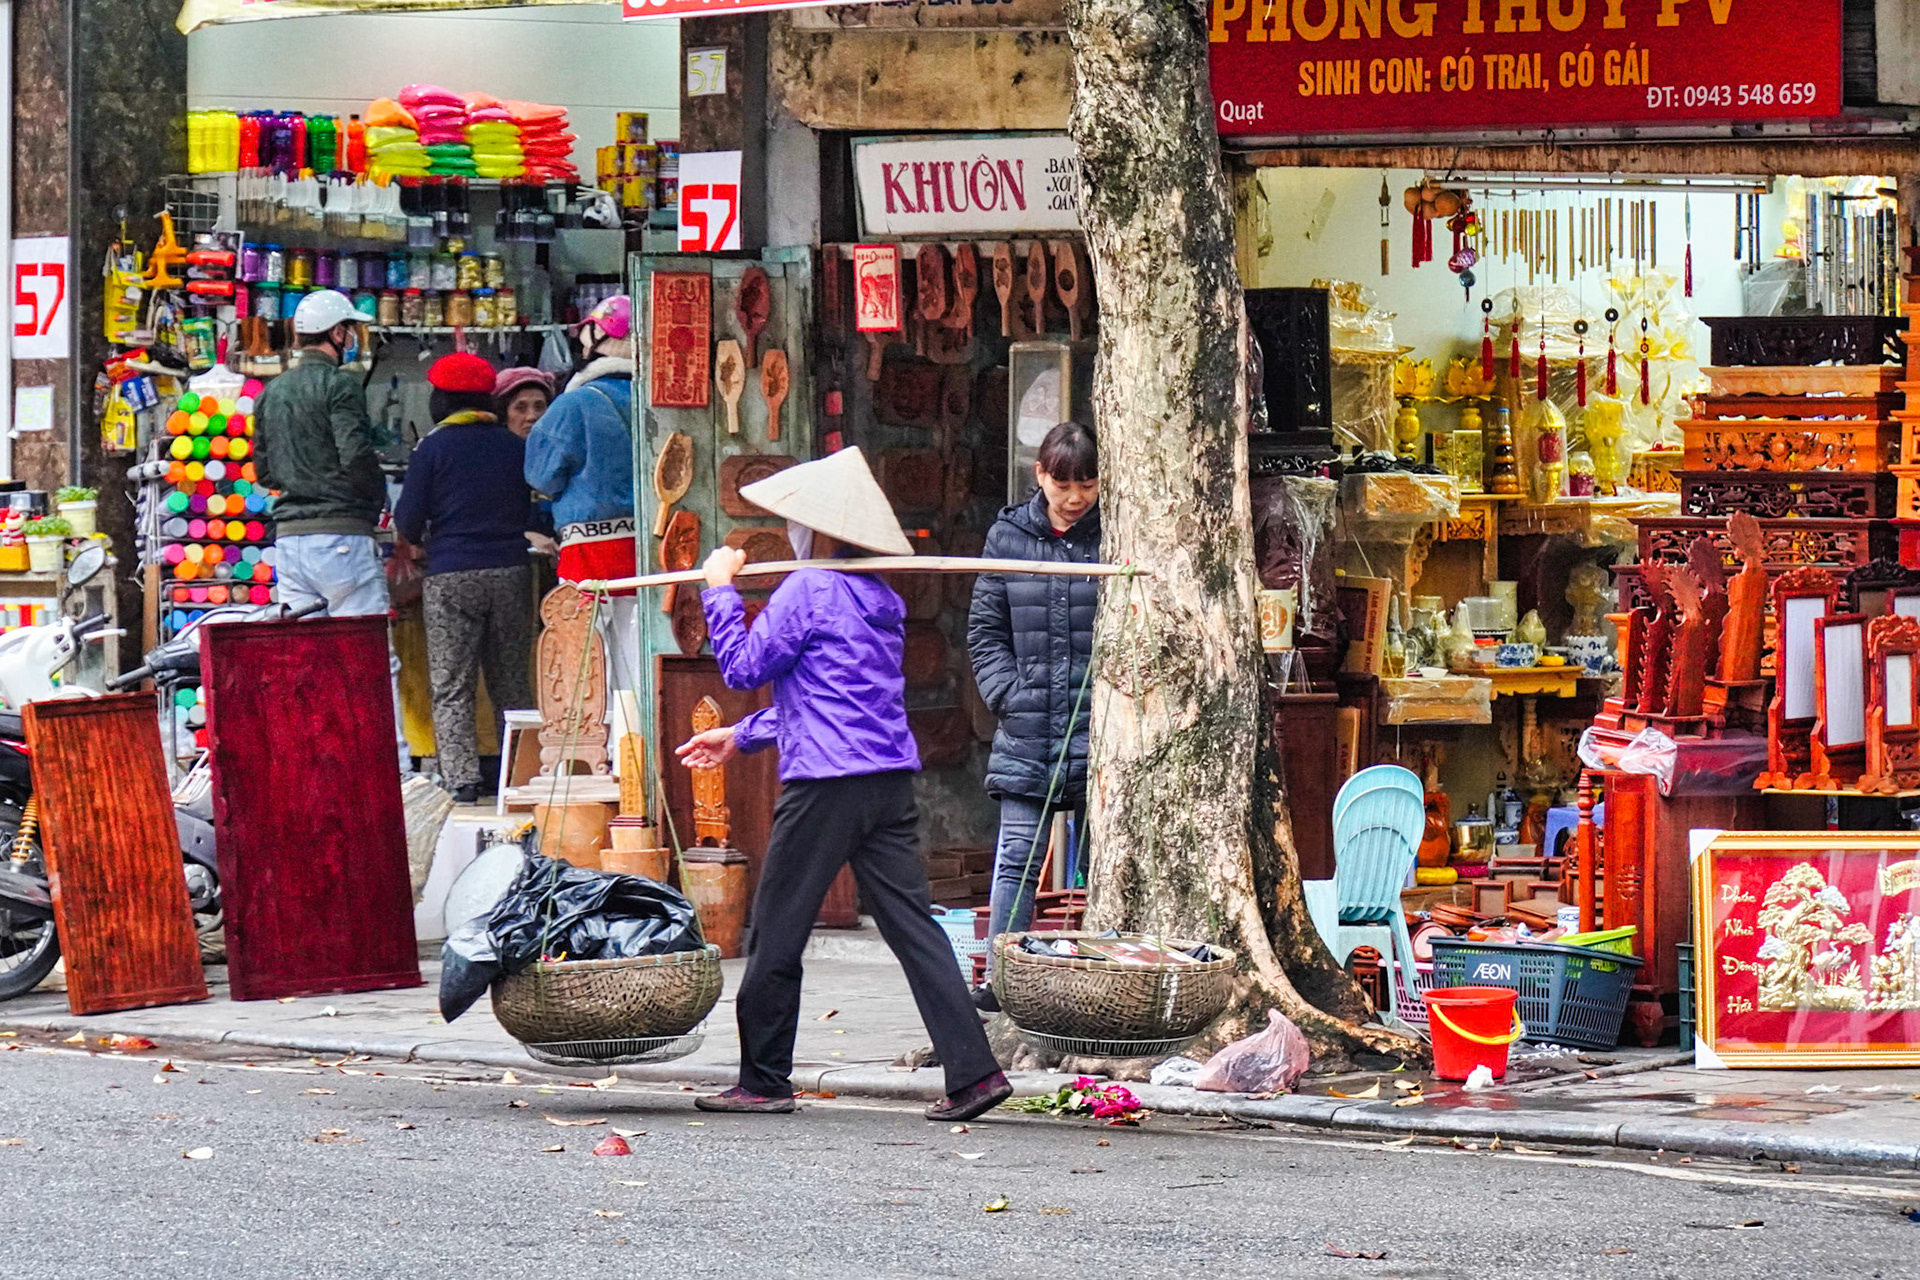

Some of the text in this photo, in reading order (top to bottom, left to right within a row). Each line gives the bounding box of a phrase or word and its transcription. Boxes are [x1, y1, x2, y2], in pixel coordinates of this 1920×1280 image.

[687, 53, 724, 97] 57
[1298, 42, 1649, 97] SINH CON: CÓ TRAI, CÓ GÁI
[1646, 82, 1817, 108] ĐT: 0943 548 659
[1219, 100, 1264, 125] Quạt
[881, 154, 1027, 214] KHUÔN
[680, 184, 738, 252] 57
[14, 263, 65, 336] 57
